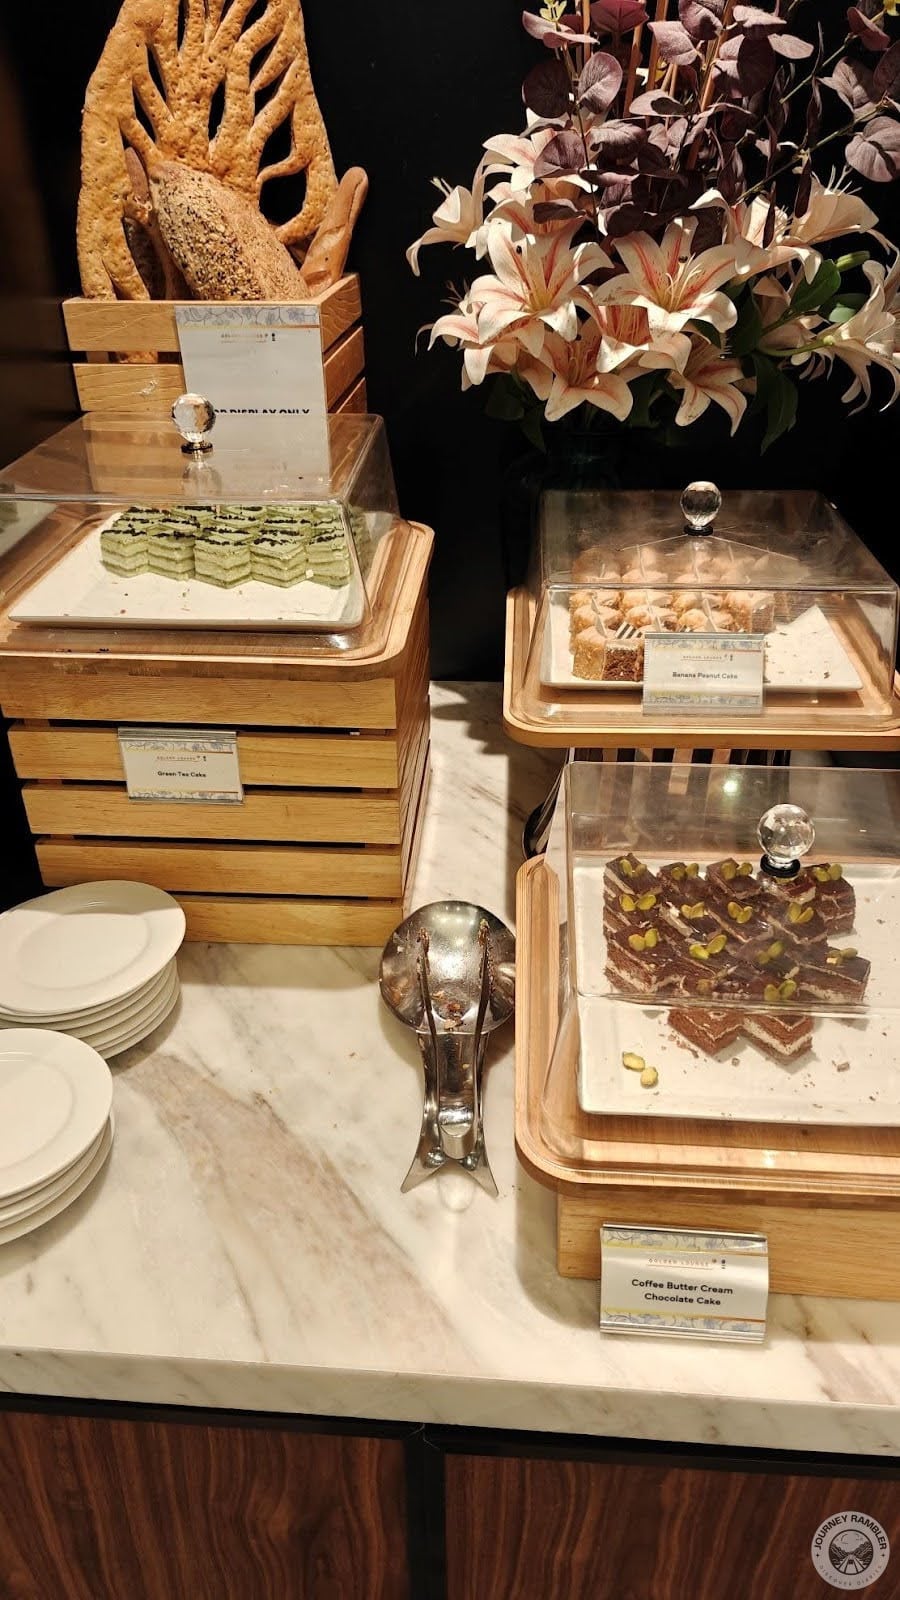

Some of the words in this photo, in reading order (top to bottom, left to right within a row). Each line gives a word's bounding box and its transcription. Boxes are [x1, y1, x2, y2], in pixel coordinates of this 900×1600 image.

[631, 1279, 664, 1289] Coffee
[666, 1282, 698, 1292] Butter
[700, 1284, 734, 1294] Cream
[644, 1292, 694, 1304] Chocolate
[696, 1296, 721, 1306] Cake
